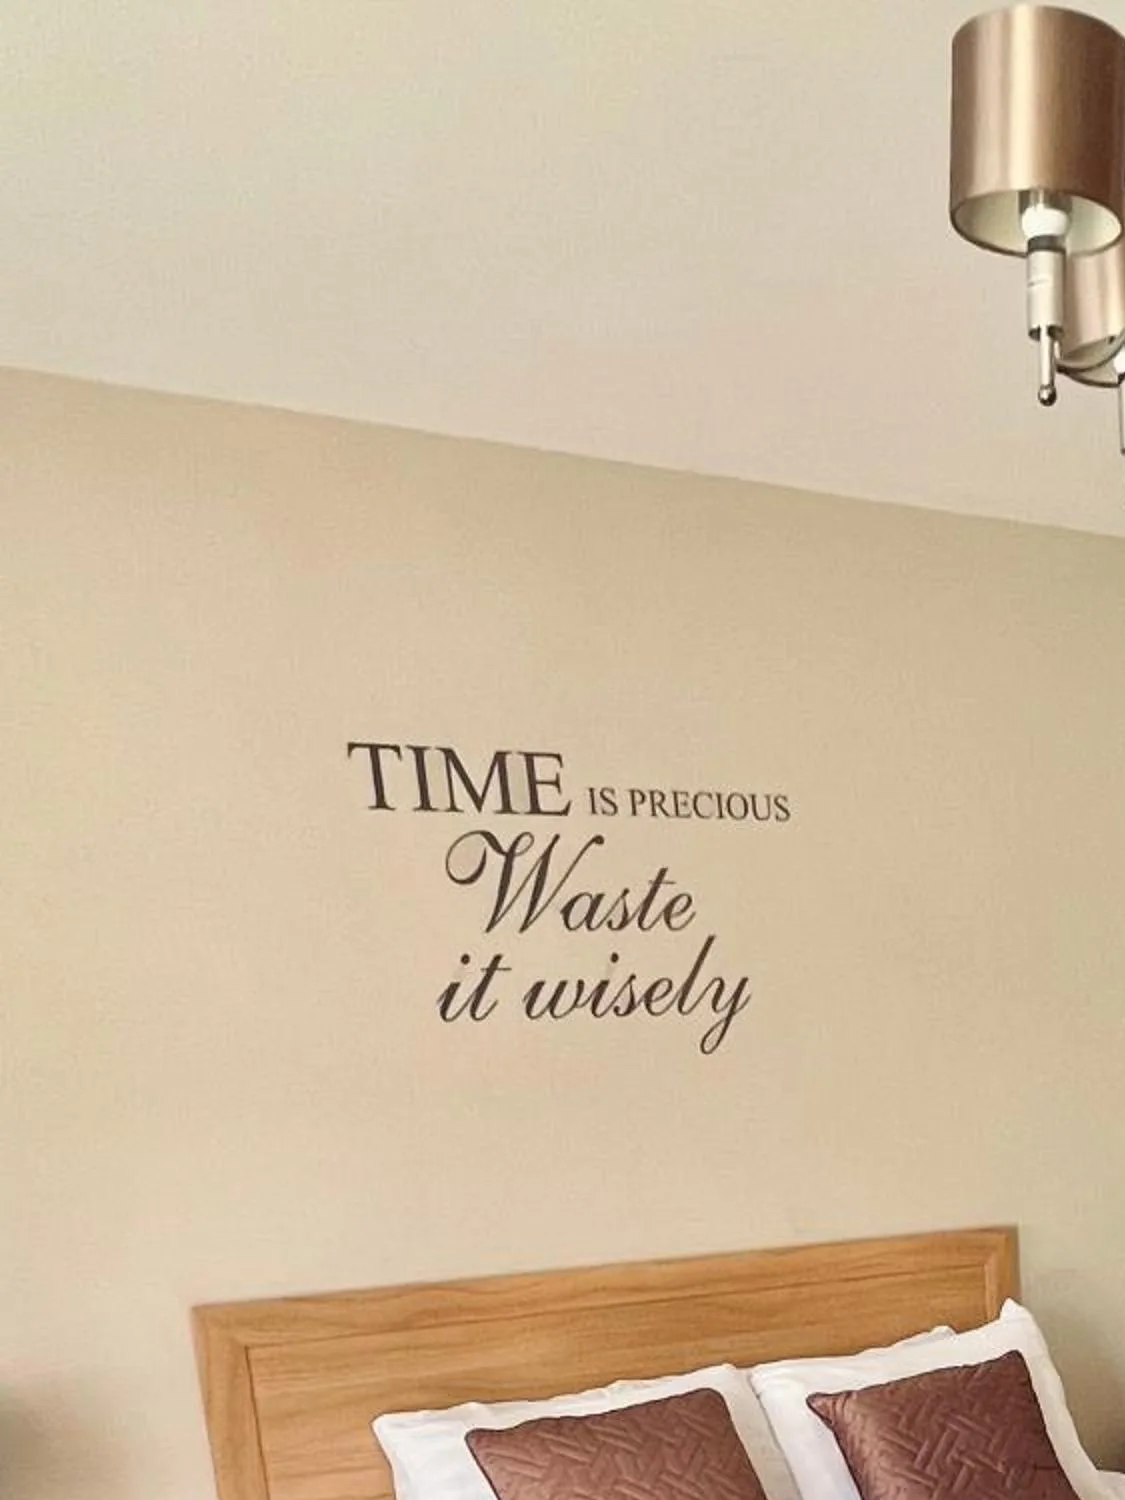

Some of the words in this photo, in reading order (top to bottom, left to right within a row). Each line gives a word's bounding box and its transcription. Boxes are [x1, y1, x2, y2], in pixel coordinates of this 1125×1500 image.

[347, 742, 572, 816] TIME
[588, 787, 619, 816] IS
[629, 789, 791, 821] PRECIOUS
[445, 830, 696, 934] Waste
[437, 953, 512, 1022] it
[522, 935, 751, 1055] wisely
